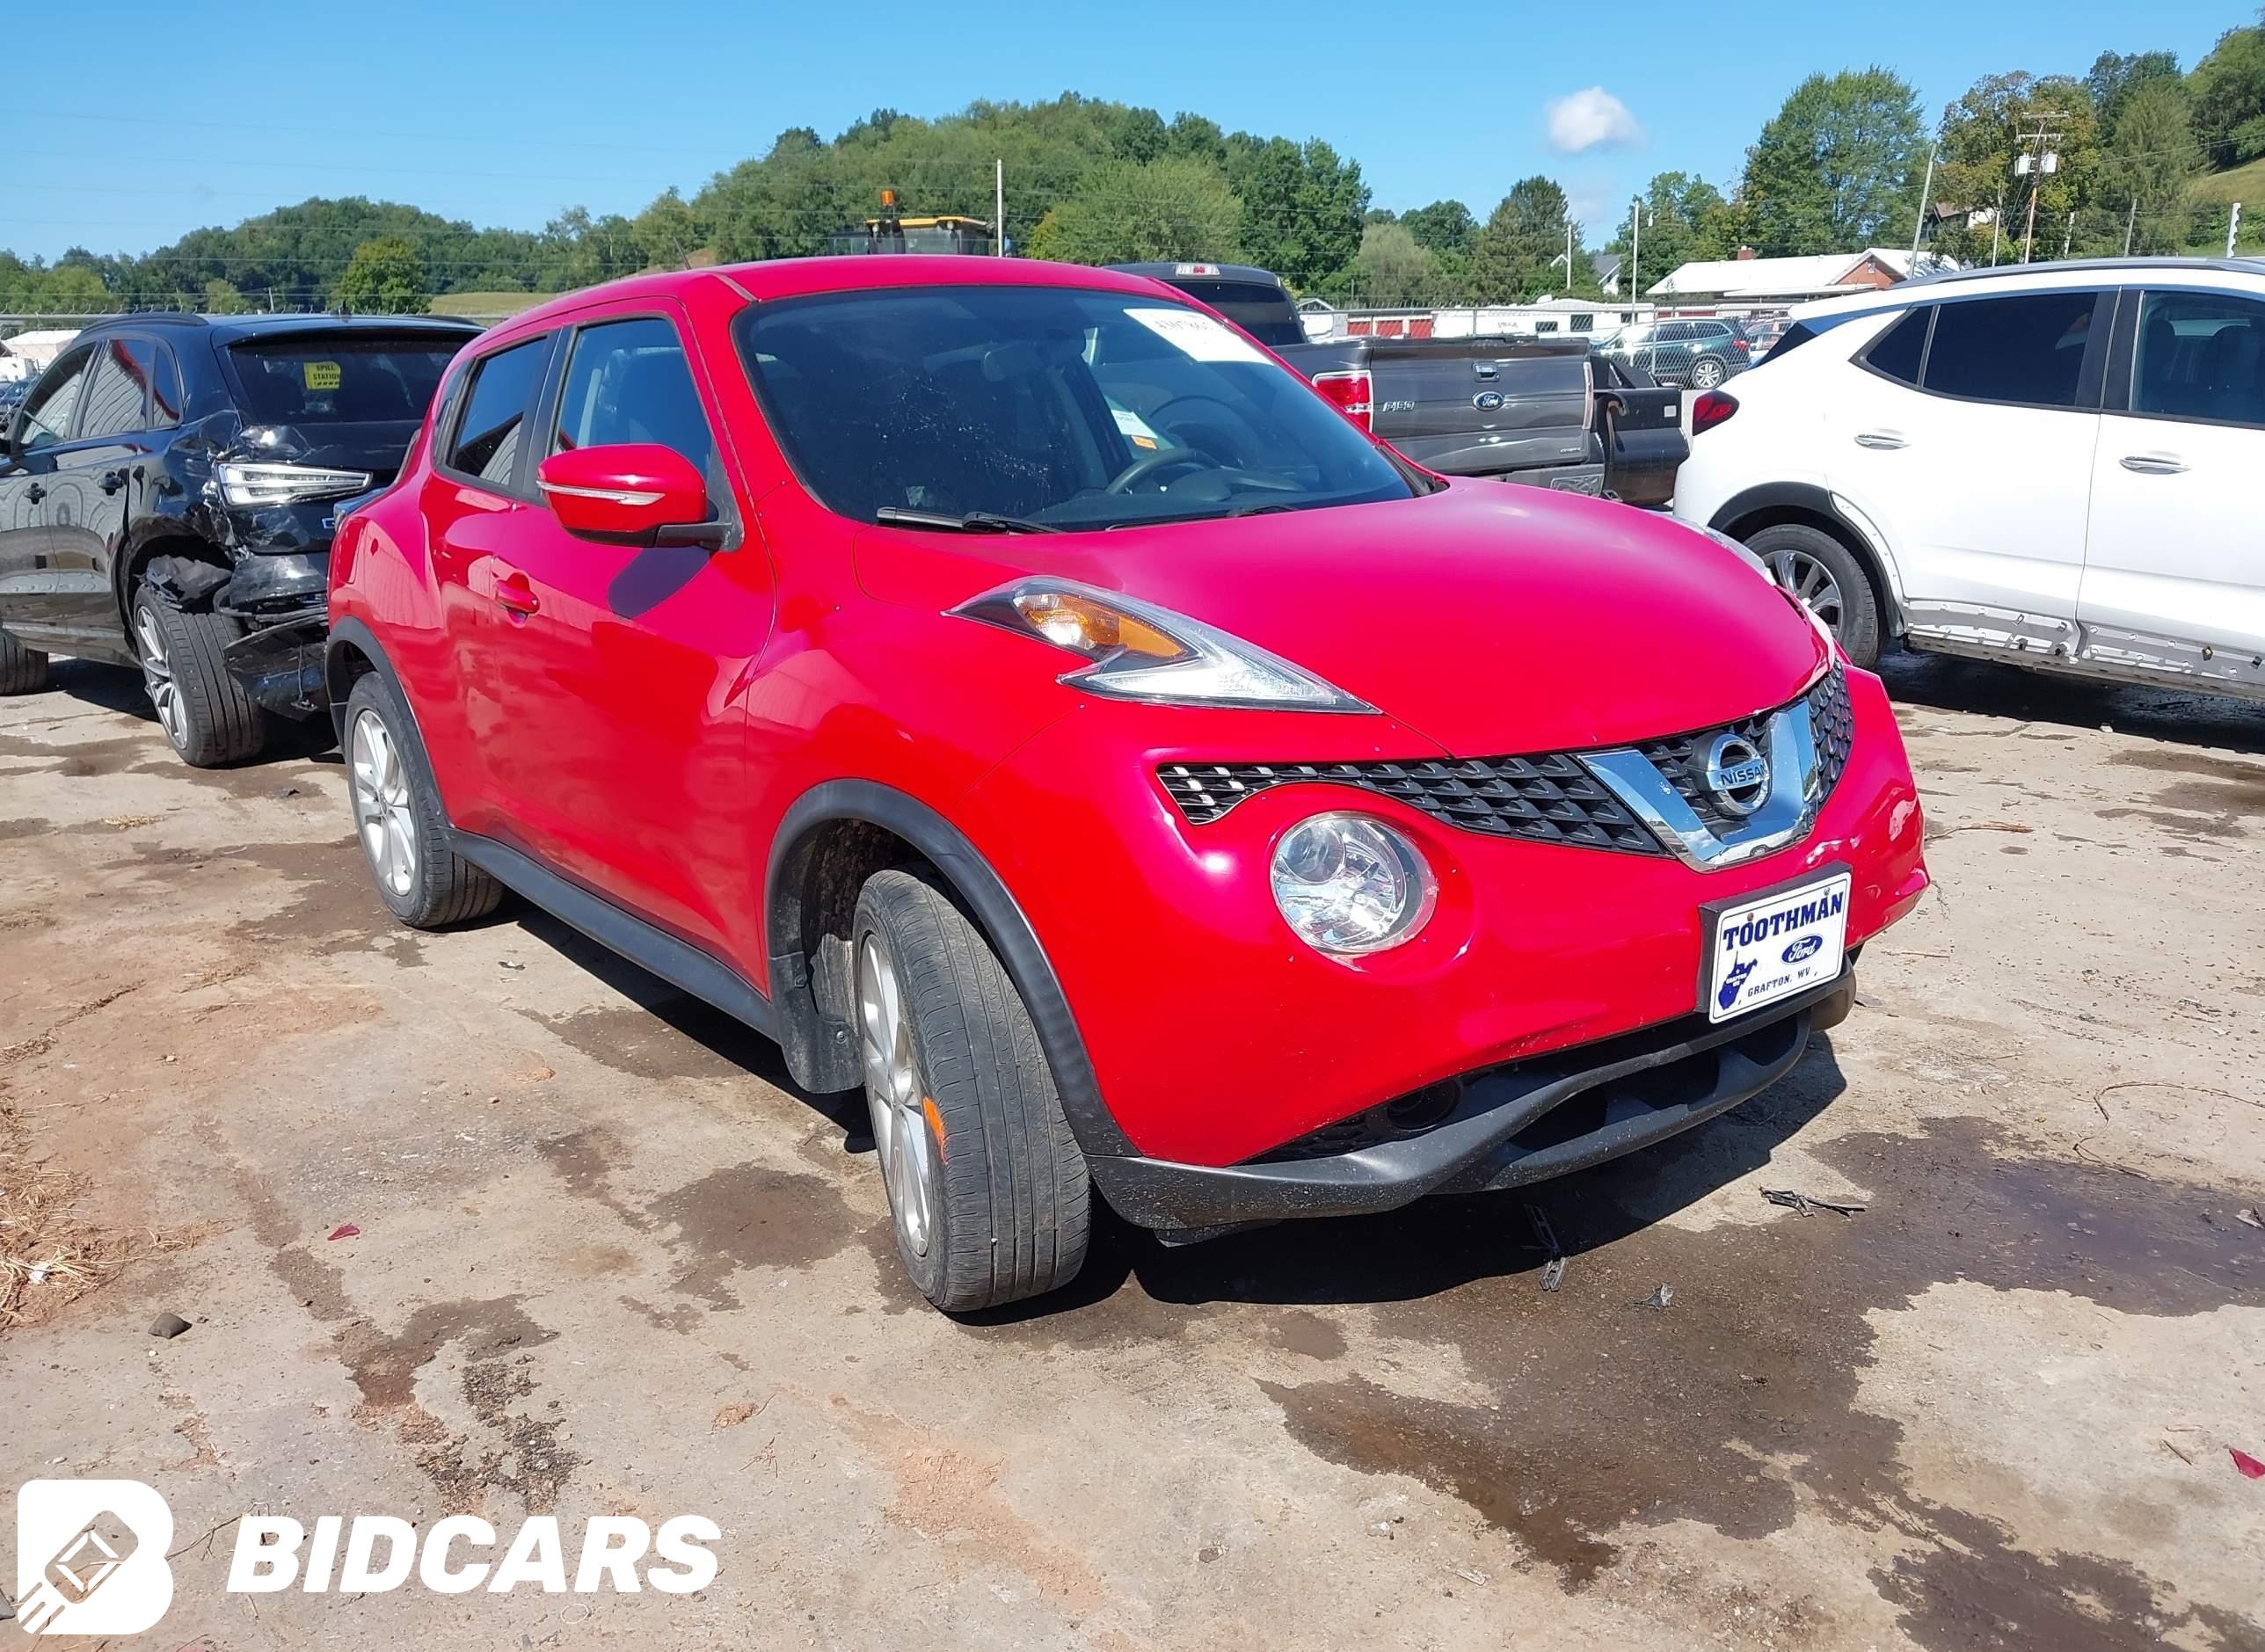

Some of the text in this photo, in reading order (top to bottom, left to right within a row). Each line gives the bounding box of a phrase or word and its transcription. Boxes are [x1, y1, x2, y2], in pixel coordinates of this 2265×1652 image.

[1720, 764, 1766, 786] NISSAN
[1722, 891, 1844, 951] TOOTHMAN
[1788, 935, 1818, 964] Ford
[1797, 967, 1811, 979] WV
